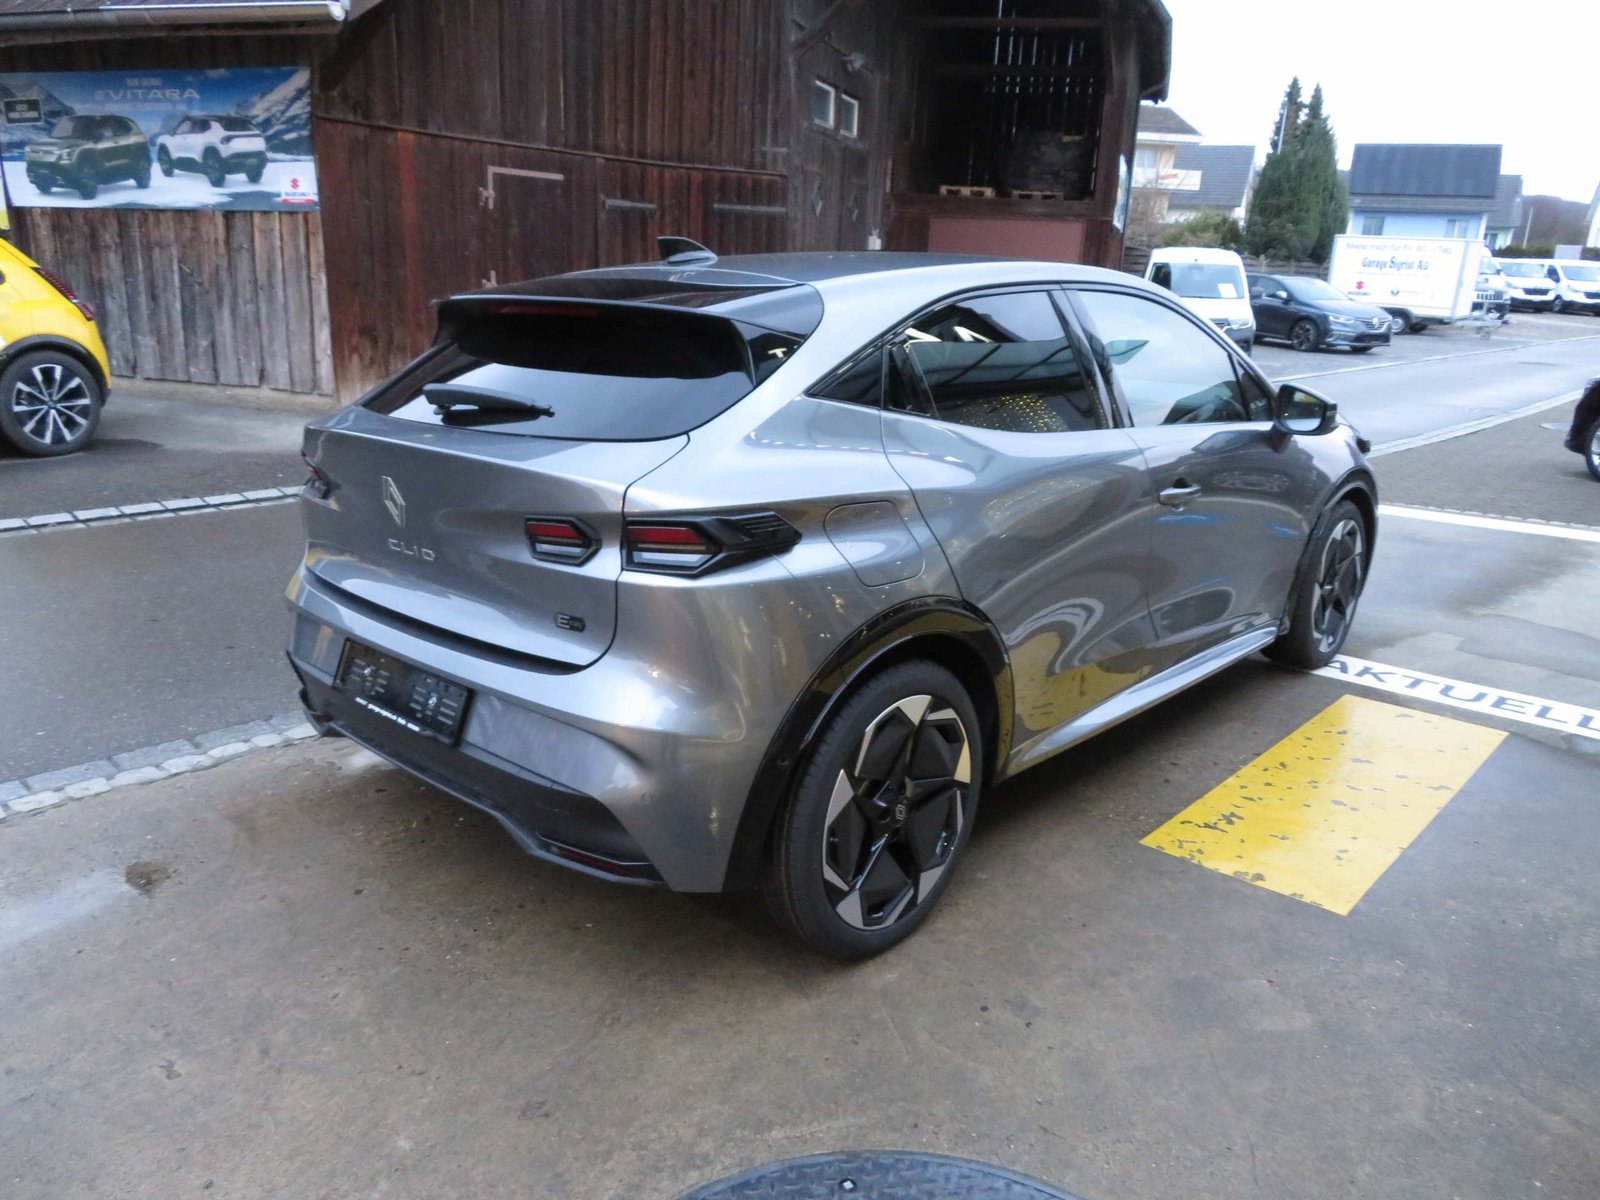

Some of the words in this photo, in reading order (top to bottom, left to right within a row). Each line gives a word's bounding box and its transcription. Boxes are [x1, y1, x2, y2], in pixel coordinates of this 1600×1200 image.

[1361, 257, 1388, 271] Garage
[1416, 260, 1431, 271] AG
[387, 538, 436, 562] CLIO
[1325, 660, 1600, 732] AKTUELL
